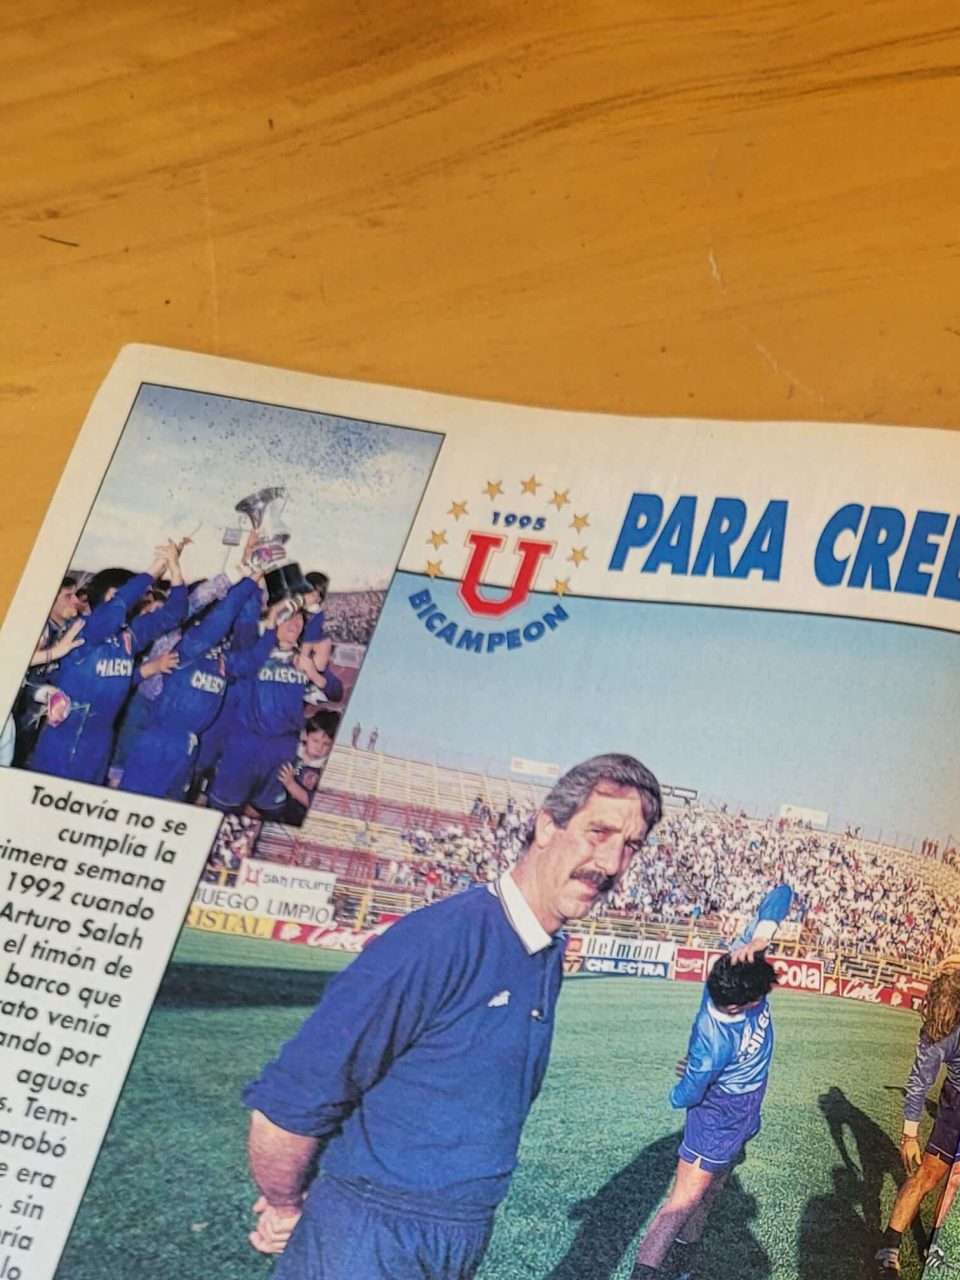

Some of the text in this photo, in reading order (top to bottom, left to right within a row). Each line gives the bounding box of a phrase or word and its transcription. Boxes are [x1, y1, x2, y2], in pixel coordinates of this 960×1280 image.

[490, 510, 546, 532] 1995
[609, 492, 789, 582] PARA
[458, 531, 558, 619] U
[408, 587, 571, 655] BICAMPEON
[30, 784, 188, 837] Todavía no se
[57, 827, 177, 865] cumplía la
[6, 870, 155, 922] 1992 cuando
[73, 861, 167, 893] semana
[0, 900, 144, 951] Arturo Salah
[267, 899, 330, 925] LIMPIO
[2, 933, 133, 980] el timón de
[586, 958, 666, 977] CHILECTRA
[3, 961, 122, 1009] barco que
